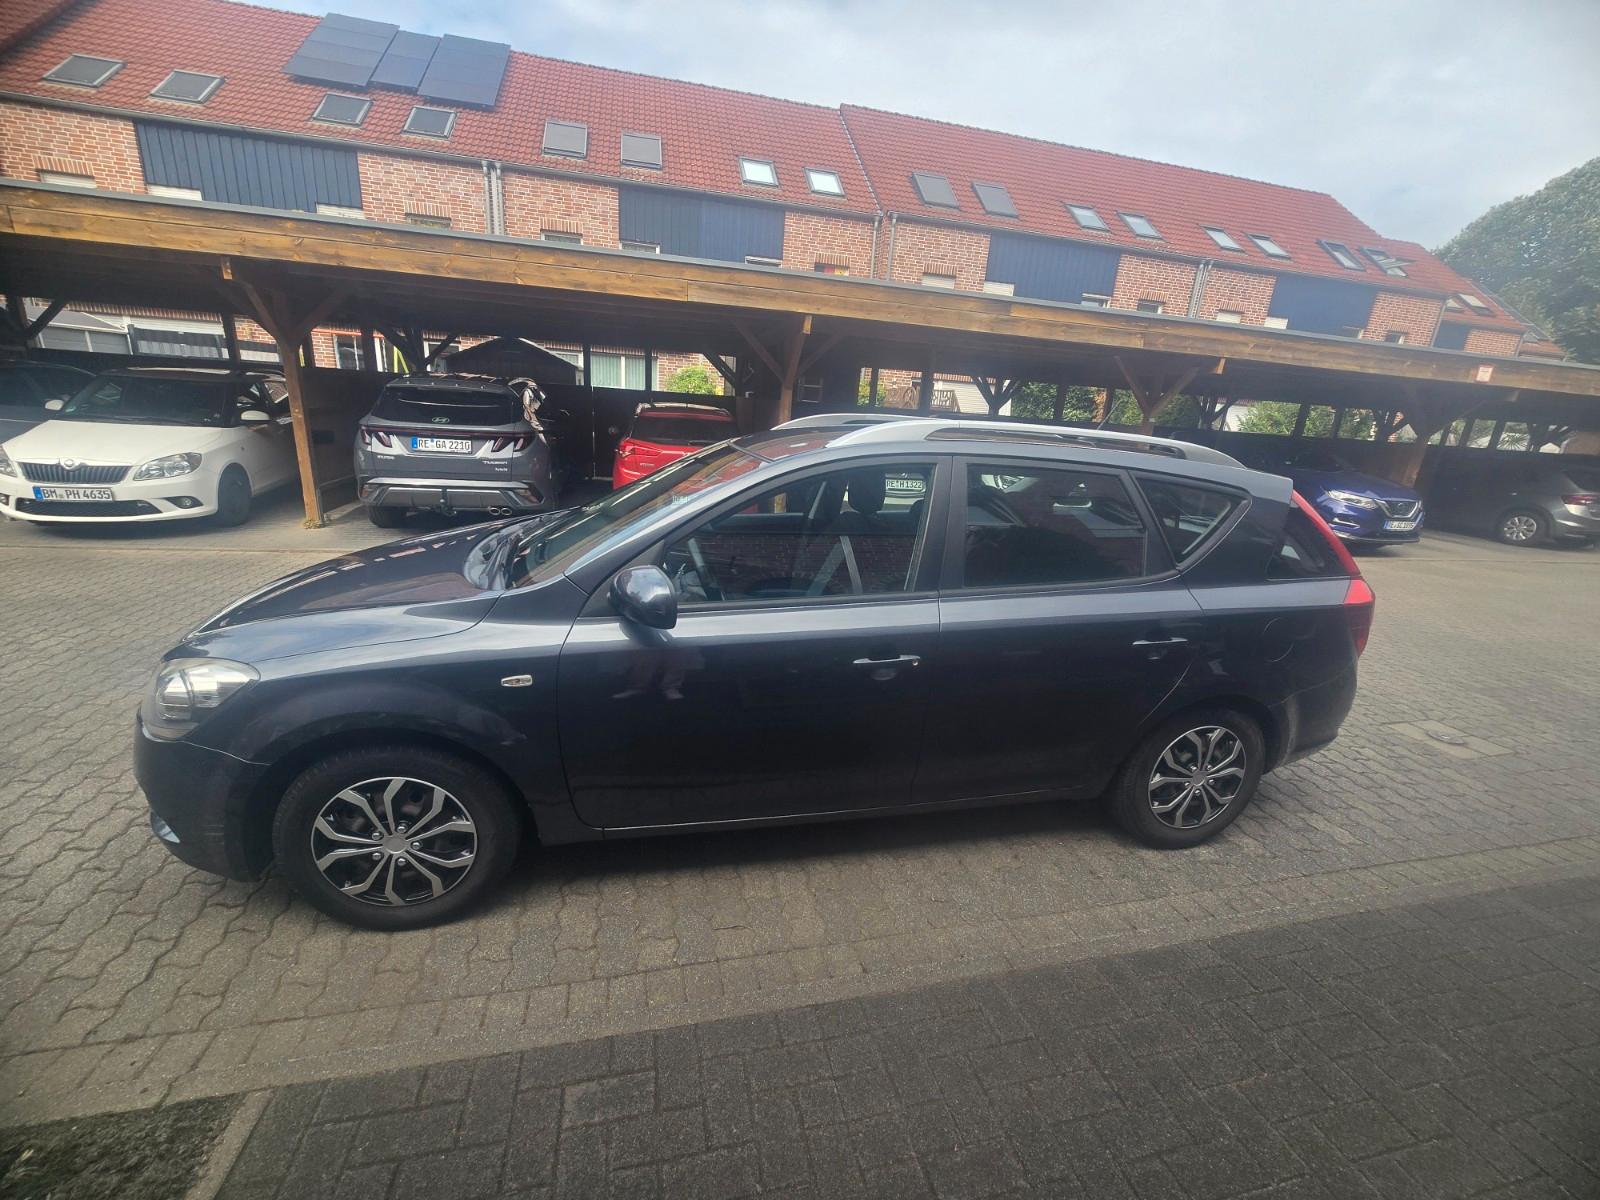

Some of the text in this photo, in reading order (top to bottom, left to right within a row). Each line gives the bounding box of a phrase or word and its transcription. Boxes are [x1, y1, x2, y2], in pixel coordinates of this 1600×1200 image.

[418, 439, 470, 450] RE GA 2210
[41, 488, 111, 499] BM PH 4635
